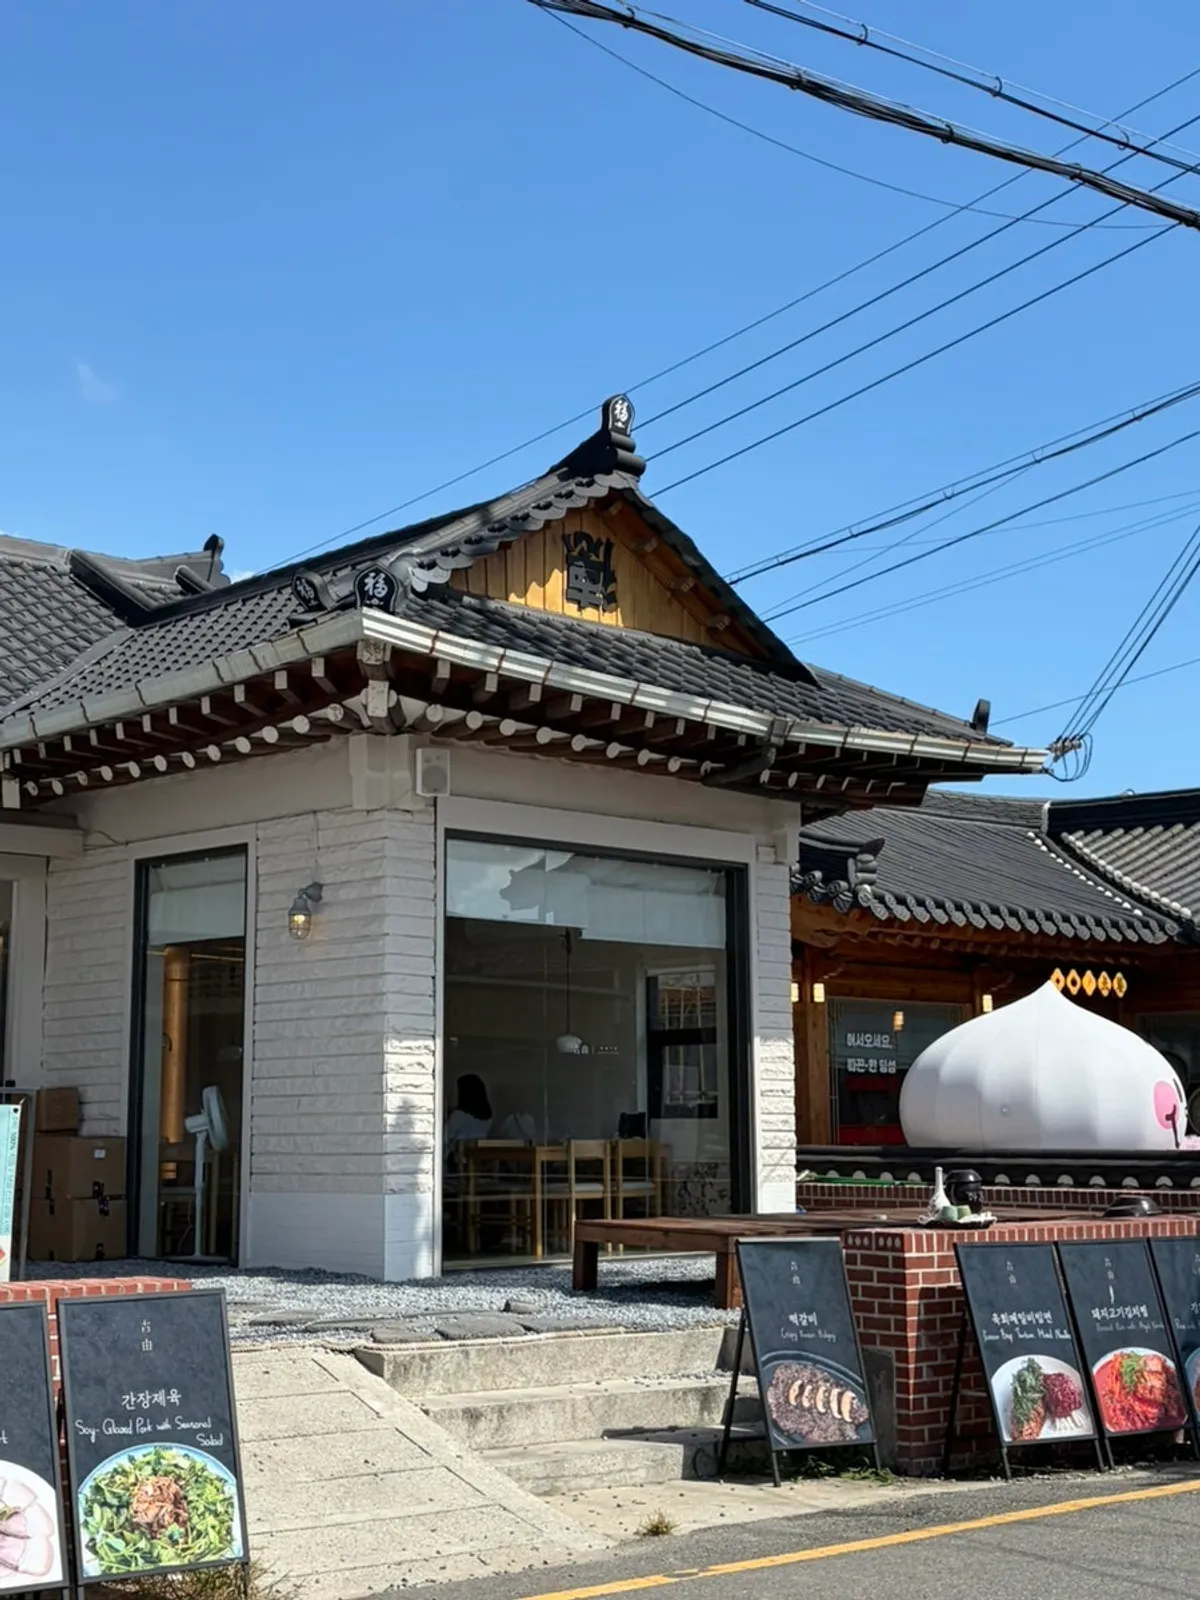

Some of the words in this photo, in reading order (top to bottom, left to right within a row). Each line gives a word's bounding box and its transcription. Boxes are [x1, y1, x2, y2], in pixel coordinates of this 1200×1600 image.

[363, 572, 389, 598] 福
[121, 1388, 182, 1411] 간장제육
[136, 1417, 153, 1434] Pork
[156, 1418, 172, 1431] with
[174, 1415, 212, 1430] Seasonal
[195, 1433, 224, 1447] Salad
